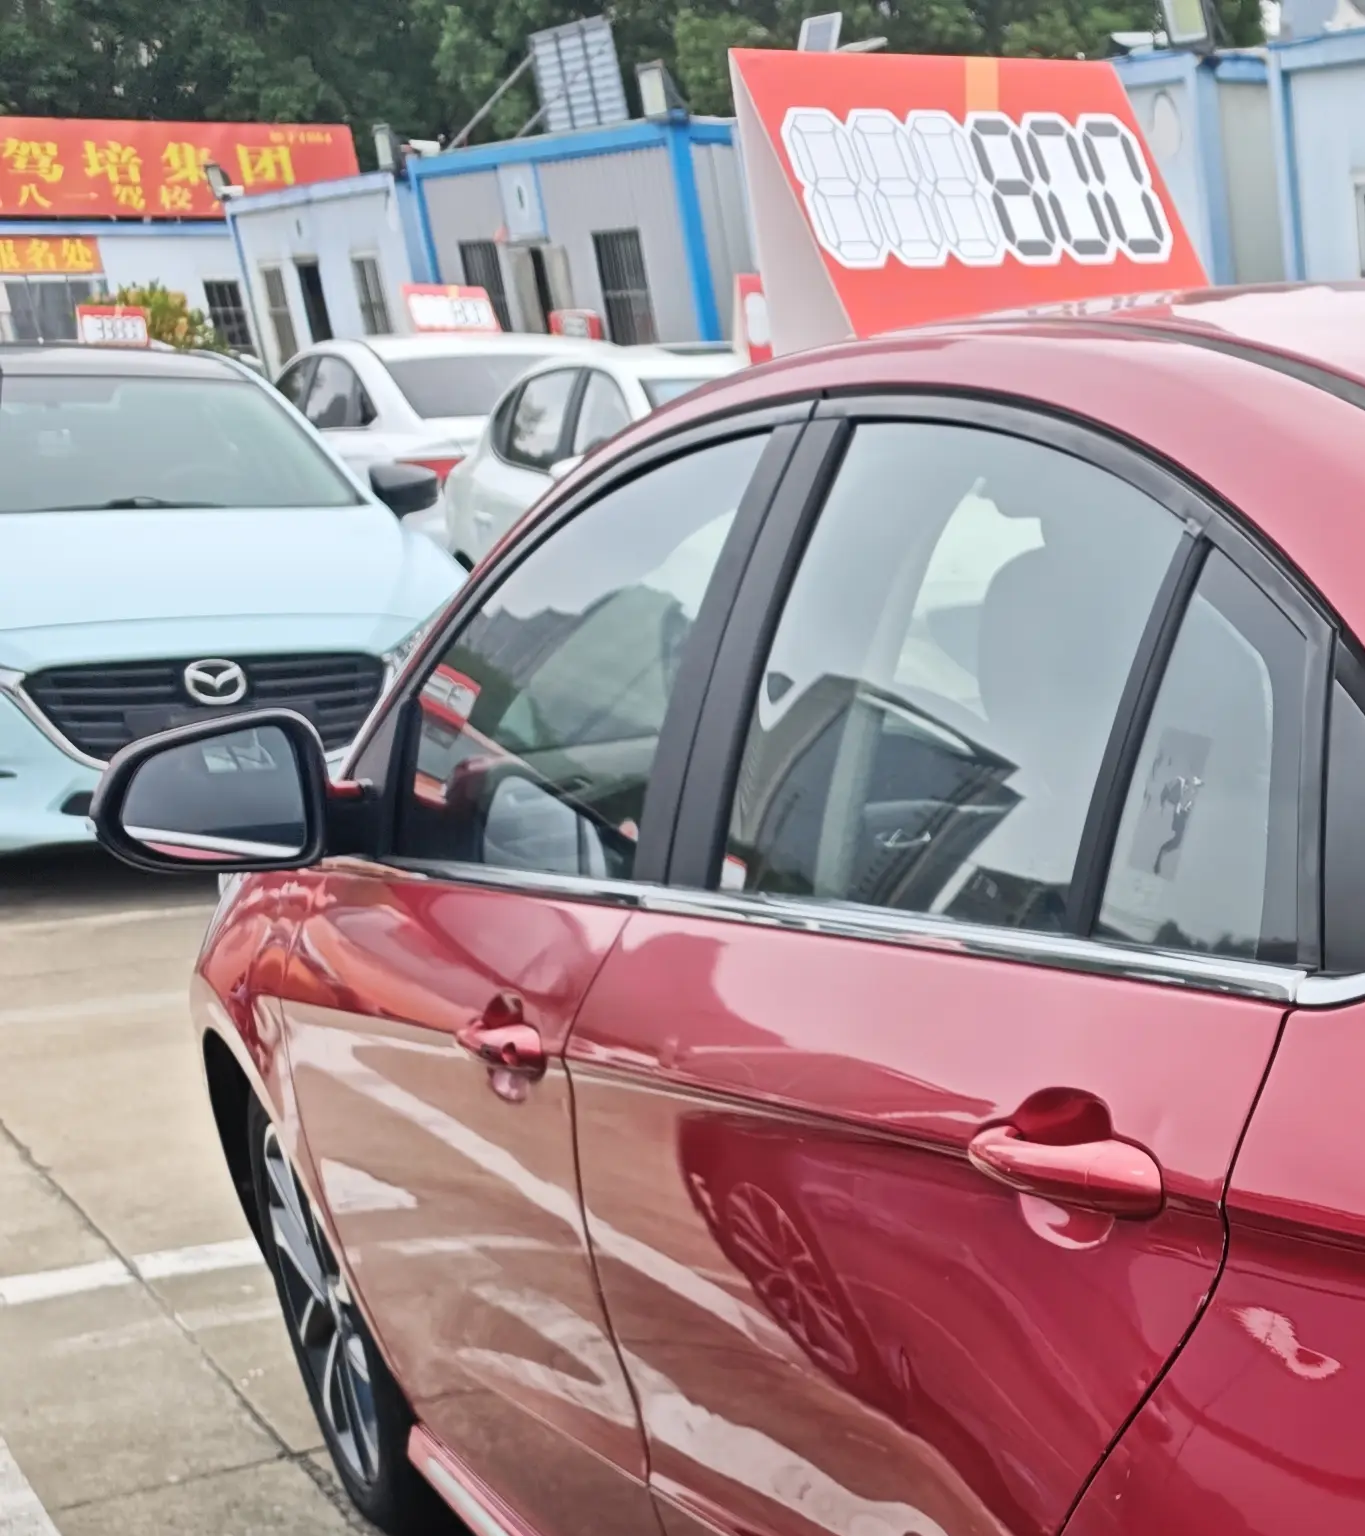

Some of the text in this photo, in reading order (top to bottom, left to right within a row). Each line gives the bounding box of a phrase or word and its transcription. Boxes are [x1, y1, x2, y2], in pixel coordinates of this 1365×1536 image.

[17, 183, 221, 210] 八一驾校
[970, 117, 1166, 257] 800
